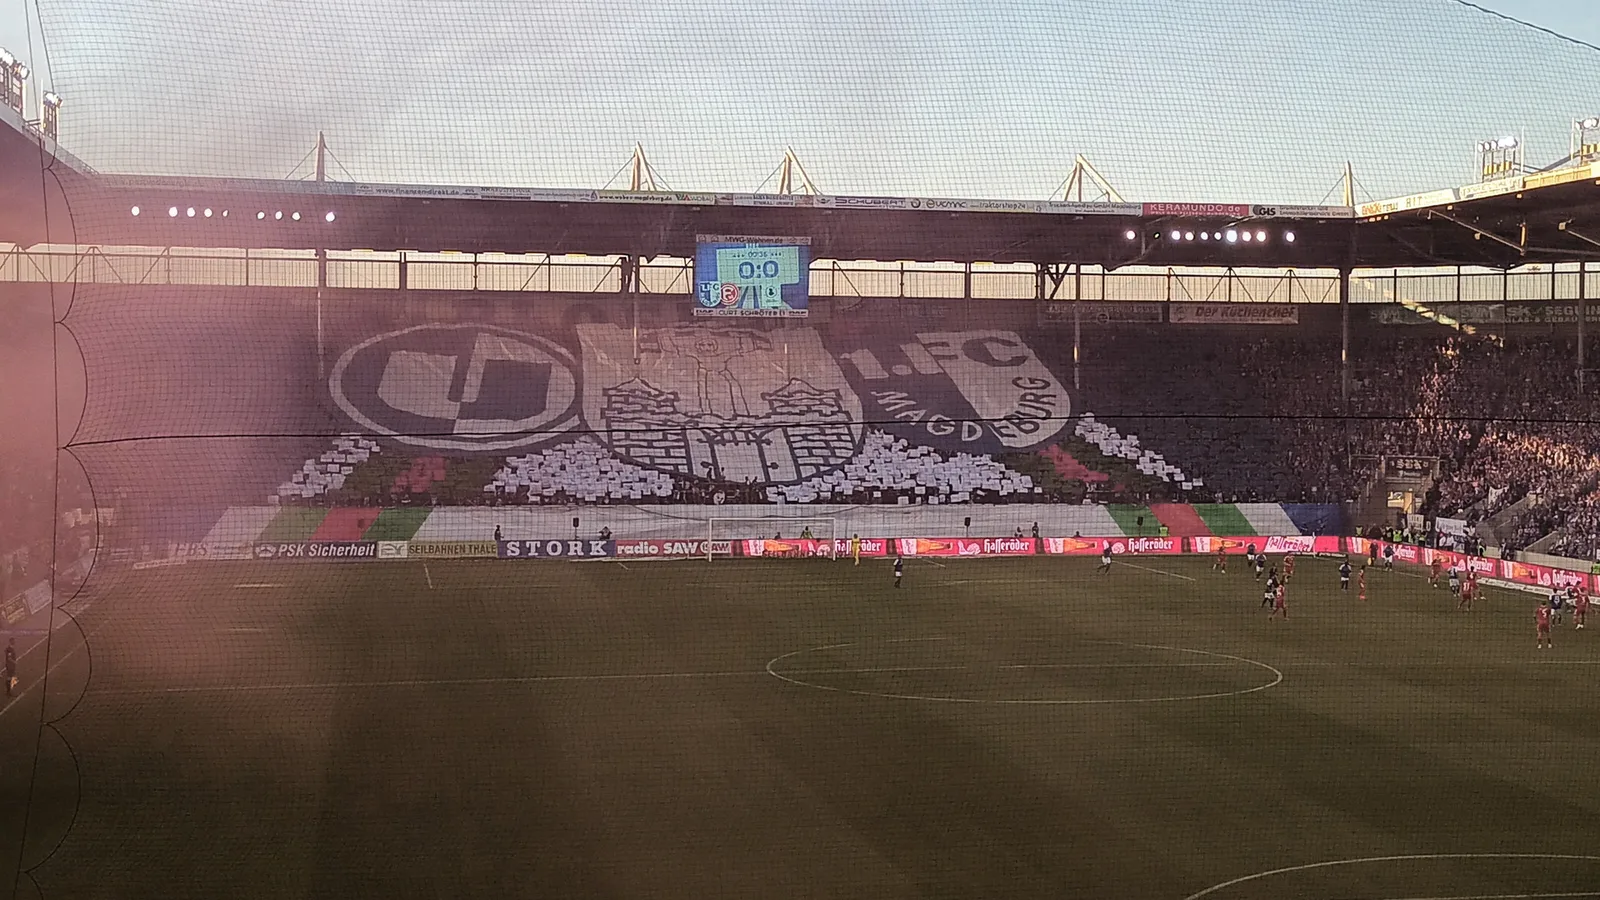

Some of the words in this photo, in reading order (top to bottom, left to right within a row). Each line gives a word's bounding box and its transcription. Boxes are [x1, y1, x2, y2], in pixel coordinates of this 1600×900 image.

[835, 197, 906, 205] SCHUBERT
[738, 260, 779, 280] 0:0
[1195, 306, 1216, 317] Der
[870, 376, 1058, 442] MAGDEBURG
[278, 544, 305, 557] PSK
[308, 543, 376, 557] Sicherheit
[409, 544, 467, 555] SEILBAHNEN
[468, 544, 496, 555] THALE
[506, 541, 608, 556] STORK
[617, 541, 659, 555] radio
[663, 541, 698, 555] SAW
